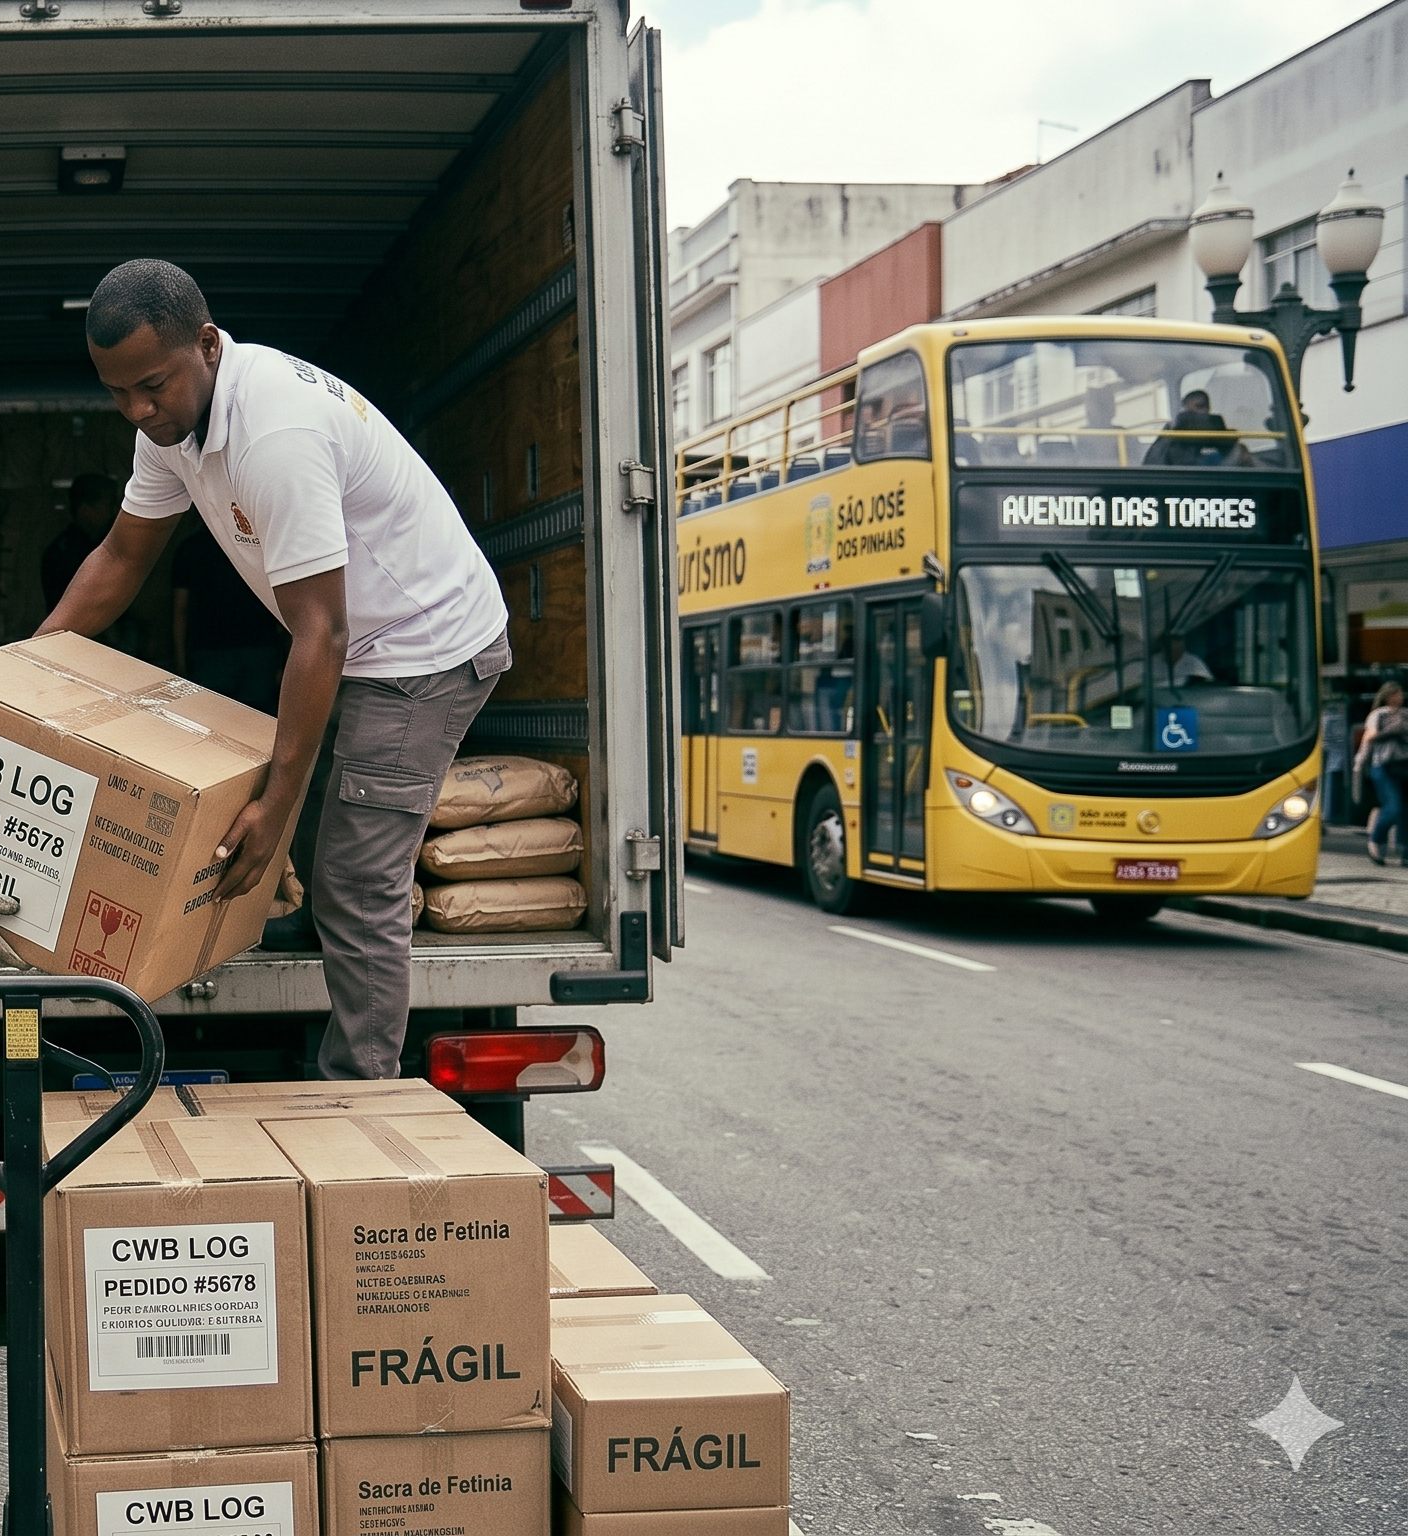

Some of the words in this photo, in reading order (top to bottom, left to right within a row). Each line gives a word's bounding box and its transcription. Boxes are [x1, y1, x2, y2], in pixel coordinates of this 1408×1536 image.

[837, 495, 865, 531] SÃO
[867, 480, 905, 524] JOSÉ
[1002, 494, 1106, 526] AVENIDA
[1111, 496, 1159, 528] DAS
[1164, 497, 1256, 529] TORRES
[837, 537, 858, 560] DOS
[860, 527, 905, 556] PINHAIS
[677, 534, 747, 597] urismo
[10, 765, 75, 816] LOG
[3, 815, 65, 858] #5678
[112, 1238, 180, 1262] CWB
[189, 1235, 250, 1260] LOG
[353, 1225, 409, 1245] Sacra
[415, 1222, 437, 1242] de
[104, 1277, 188, 1297] PEDIDO
[194, 1274, 256, 1294] #5678
[351, 1336, 521, 1387] FRÁGIL
[608, 1425, 761, 1474] FRÁGIL
[358, 1480, 413, 1499] Sacra
[418, 1477, 441, 1495] de
[447, 1473, 512, 1494] Fetinia
[125, 1499, 194, 1525] CWB
[203, 1495, 265, 1521] LOG
